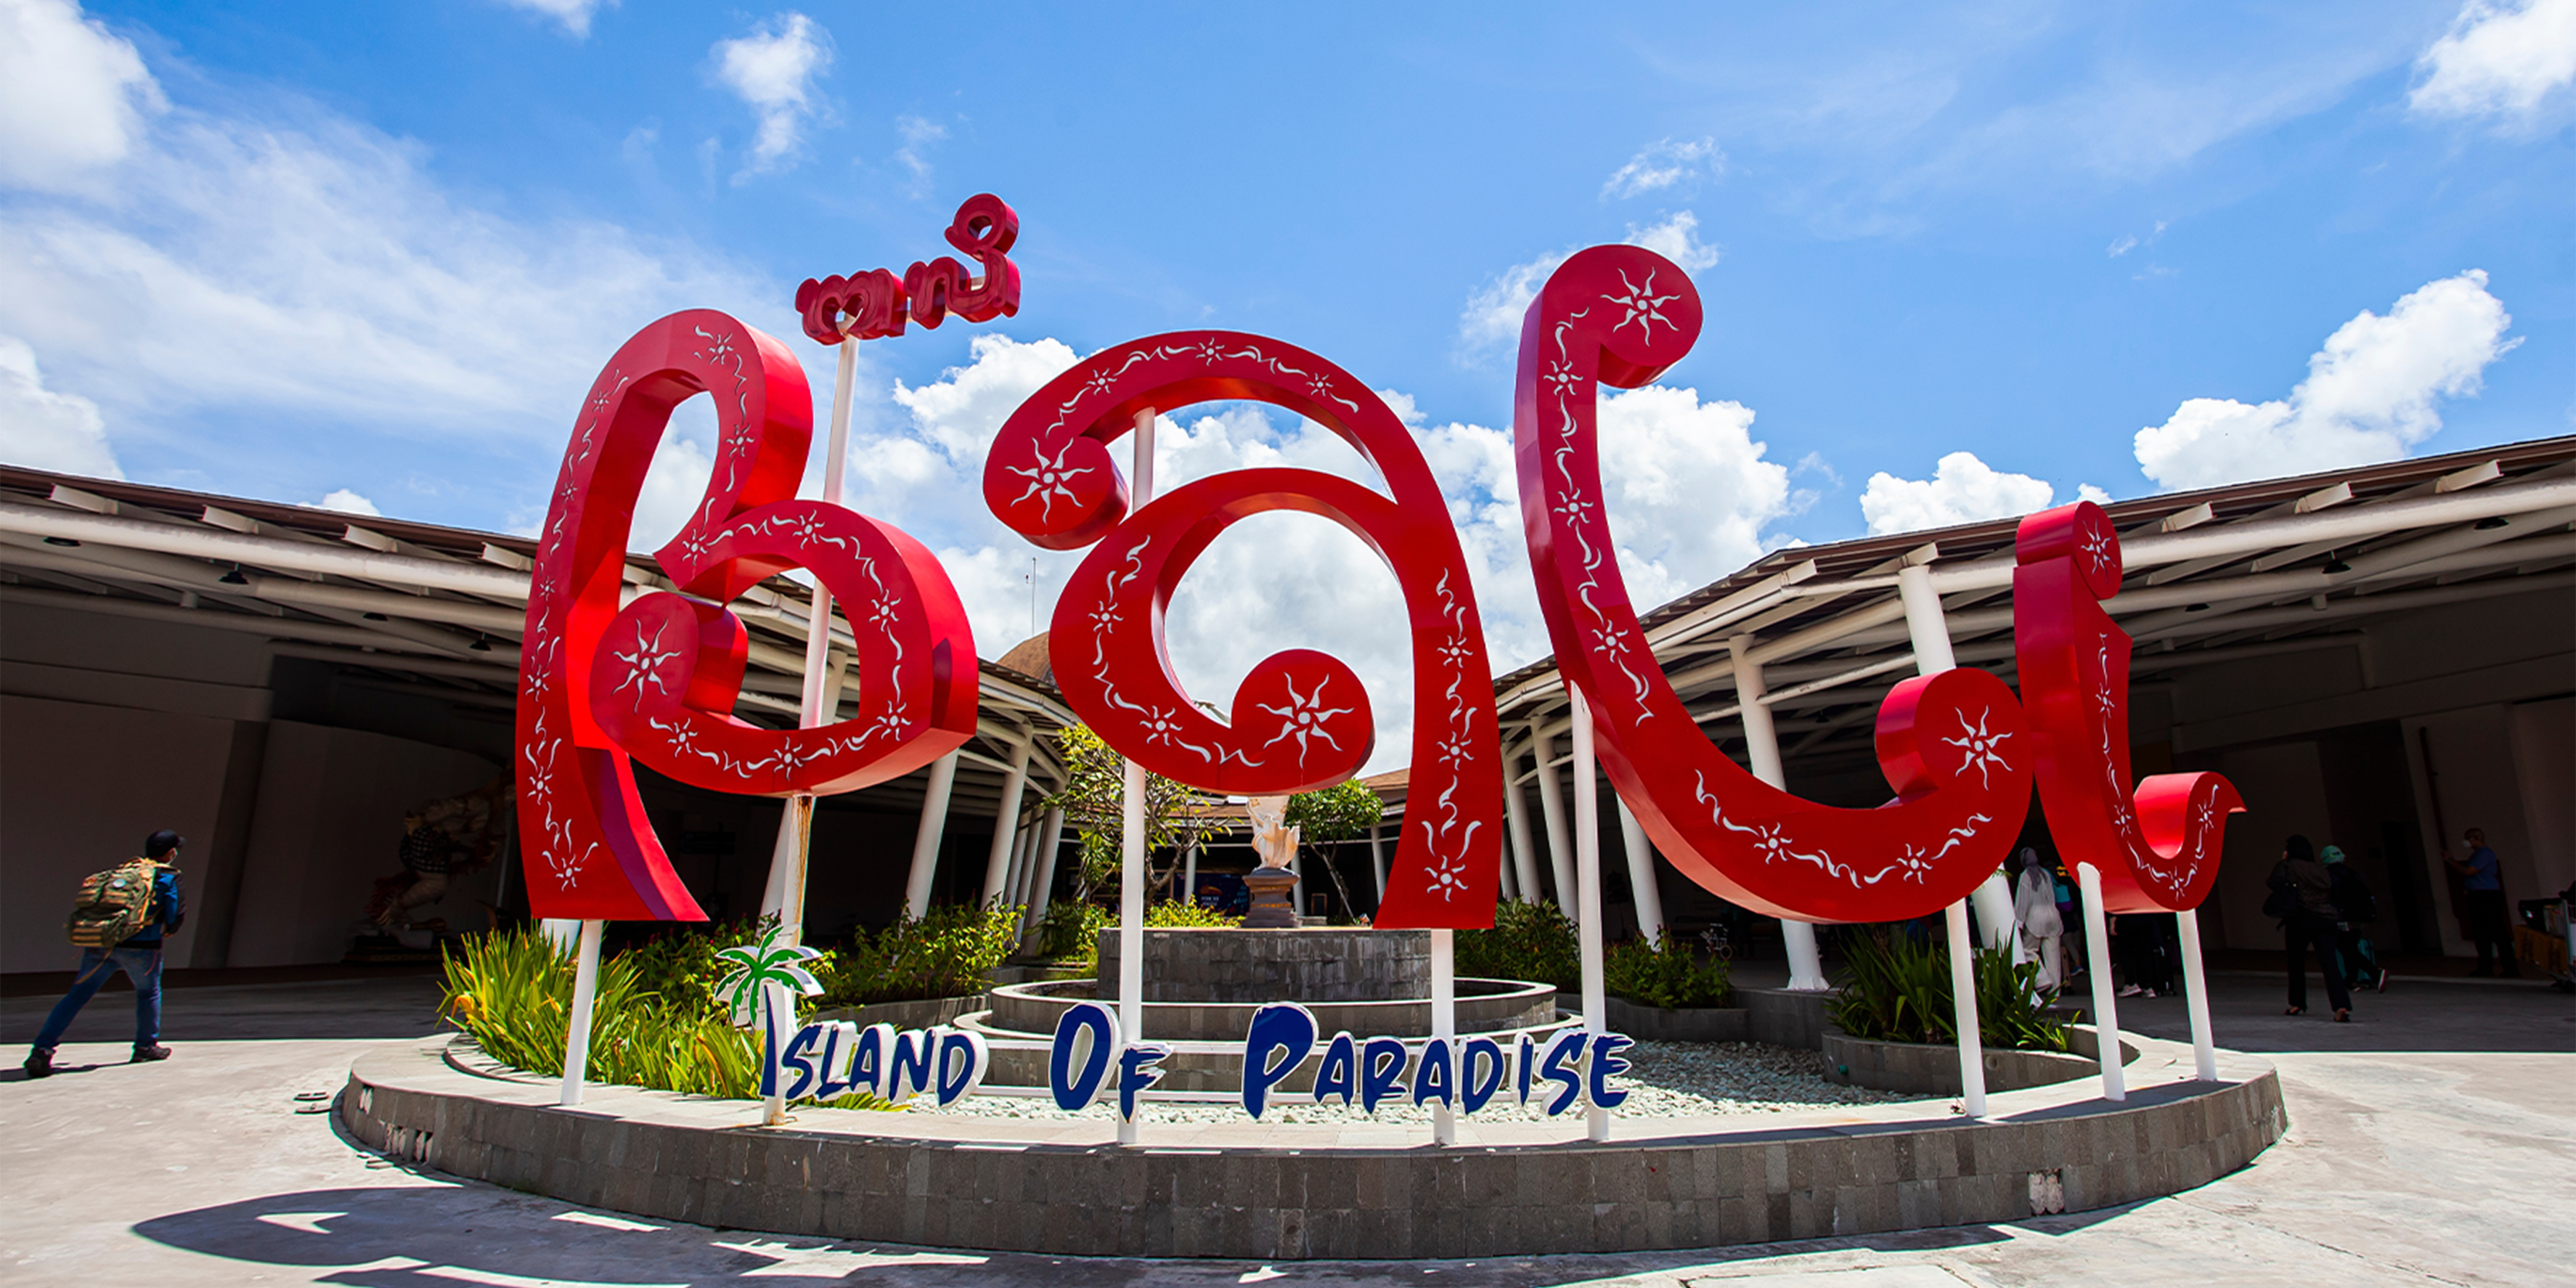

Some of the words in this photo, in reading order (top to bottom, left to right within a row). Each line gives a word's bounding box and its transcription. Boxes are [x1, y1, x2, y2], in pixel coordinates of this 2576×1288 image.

[759, 983, 982, 1106] ISLAND
[1049, 1002, 1171, 1124] OF
[1242, 1001, 1635, 1120] PARADISE
